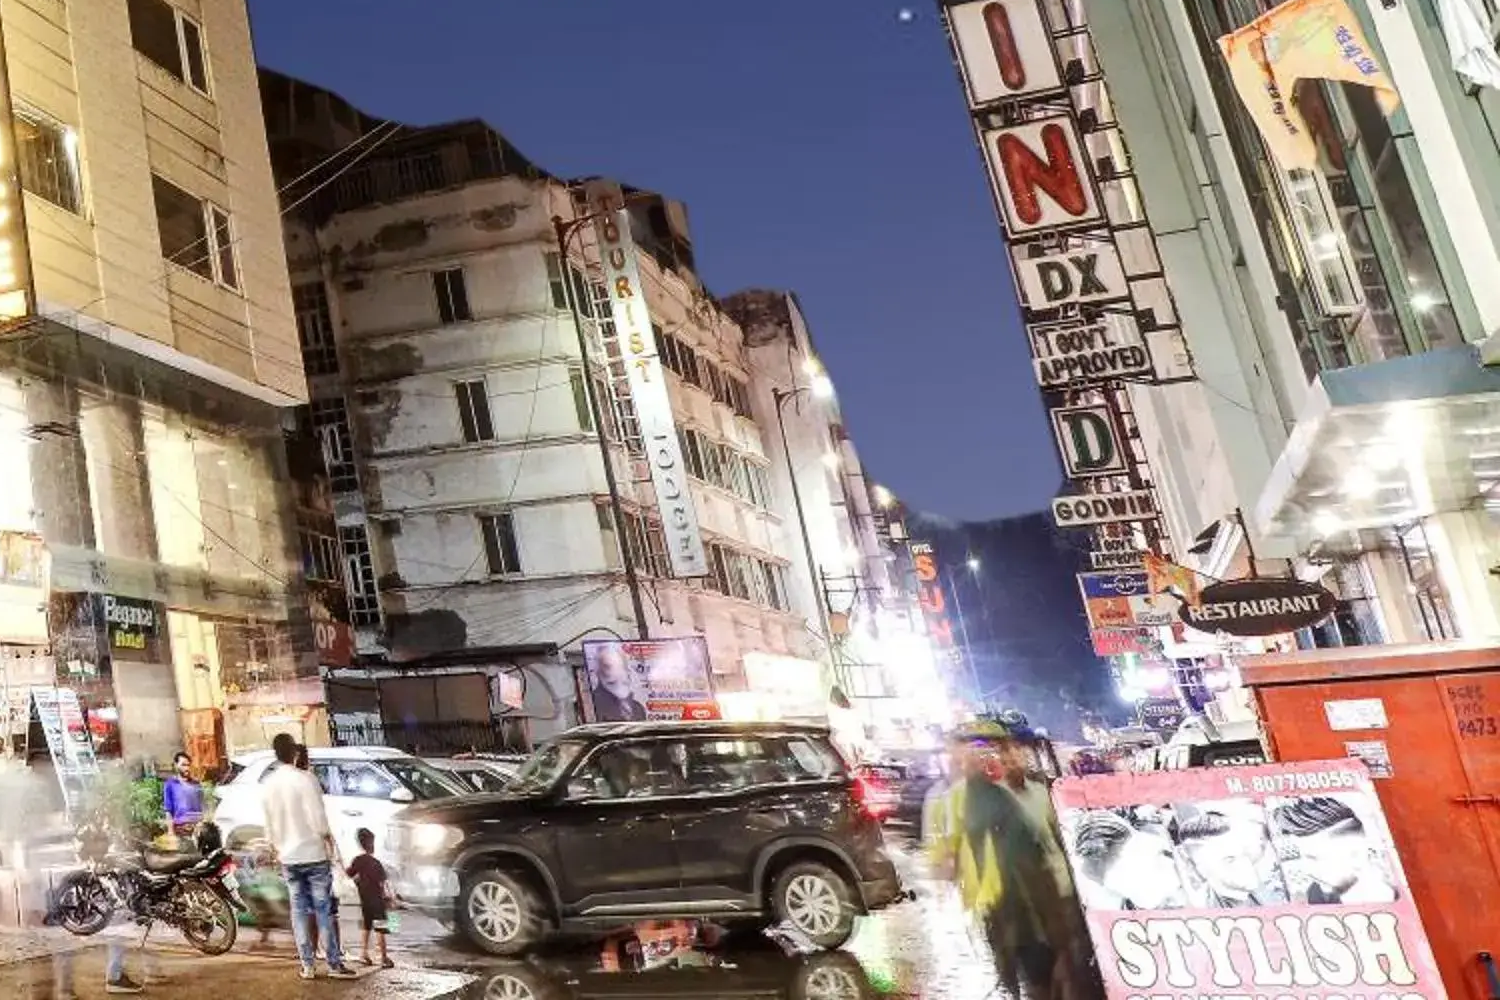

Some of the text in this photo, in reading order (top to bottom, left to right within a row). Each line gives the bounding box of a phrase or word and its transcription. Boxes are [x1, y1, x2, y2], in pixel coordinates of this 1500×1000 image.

[599, 194, 653, 384] TOURIST
[1036, 253, 1109, 303] DX
[1040, 345, 1146, 383] APPROVED
[1061, 411, 1114, 471] D
[1055, 495, 1152, 521] GODWIN
[912, 543, 933, 553] OTEL
[1095, 551, 1145, 567] APPROVE
[1188, 593, 1322, 622] RESTAURANT
[315, 622, 337, 649] OP
[1251, 770, 1363, 793] 807788056
[1110, 912, 1417, 988] STYLISH
